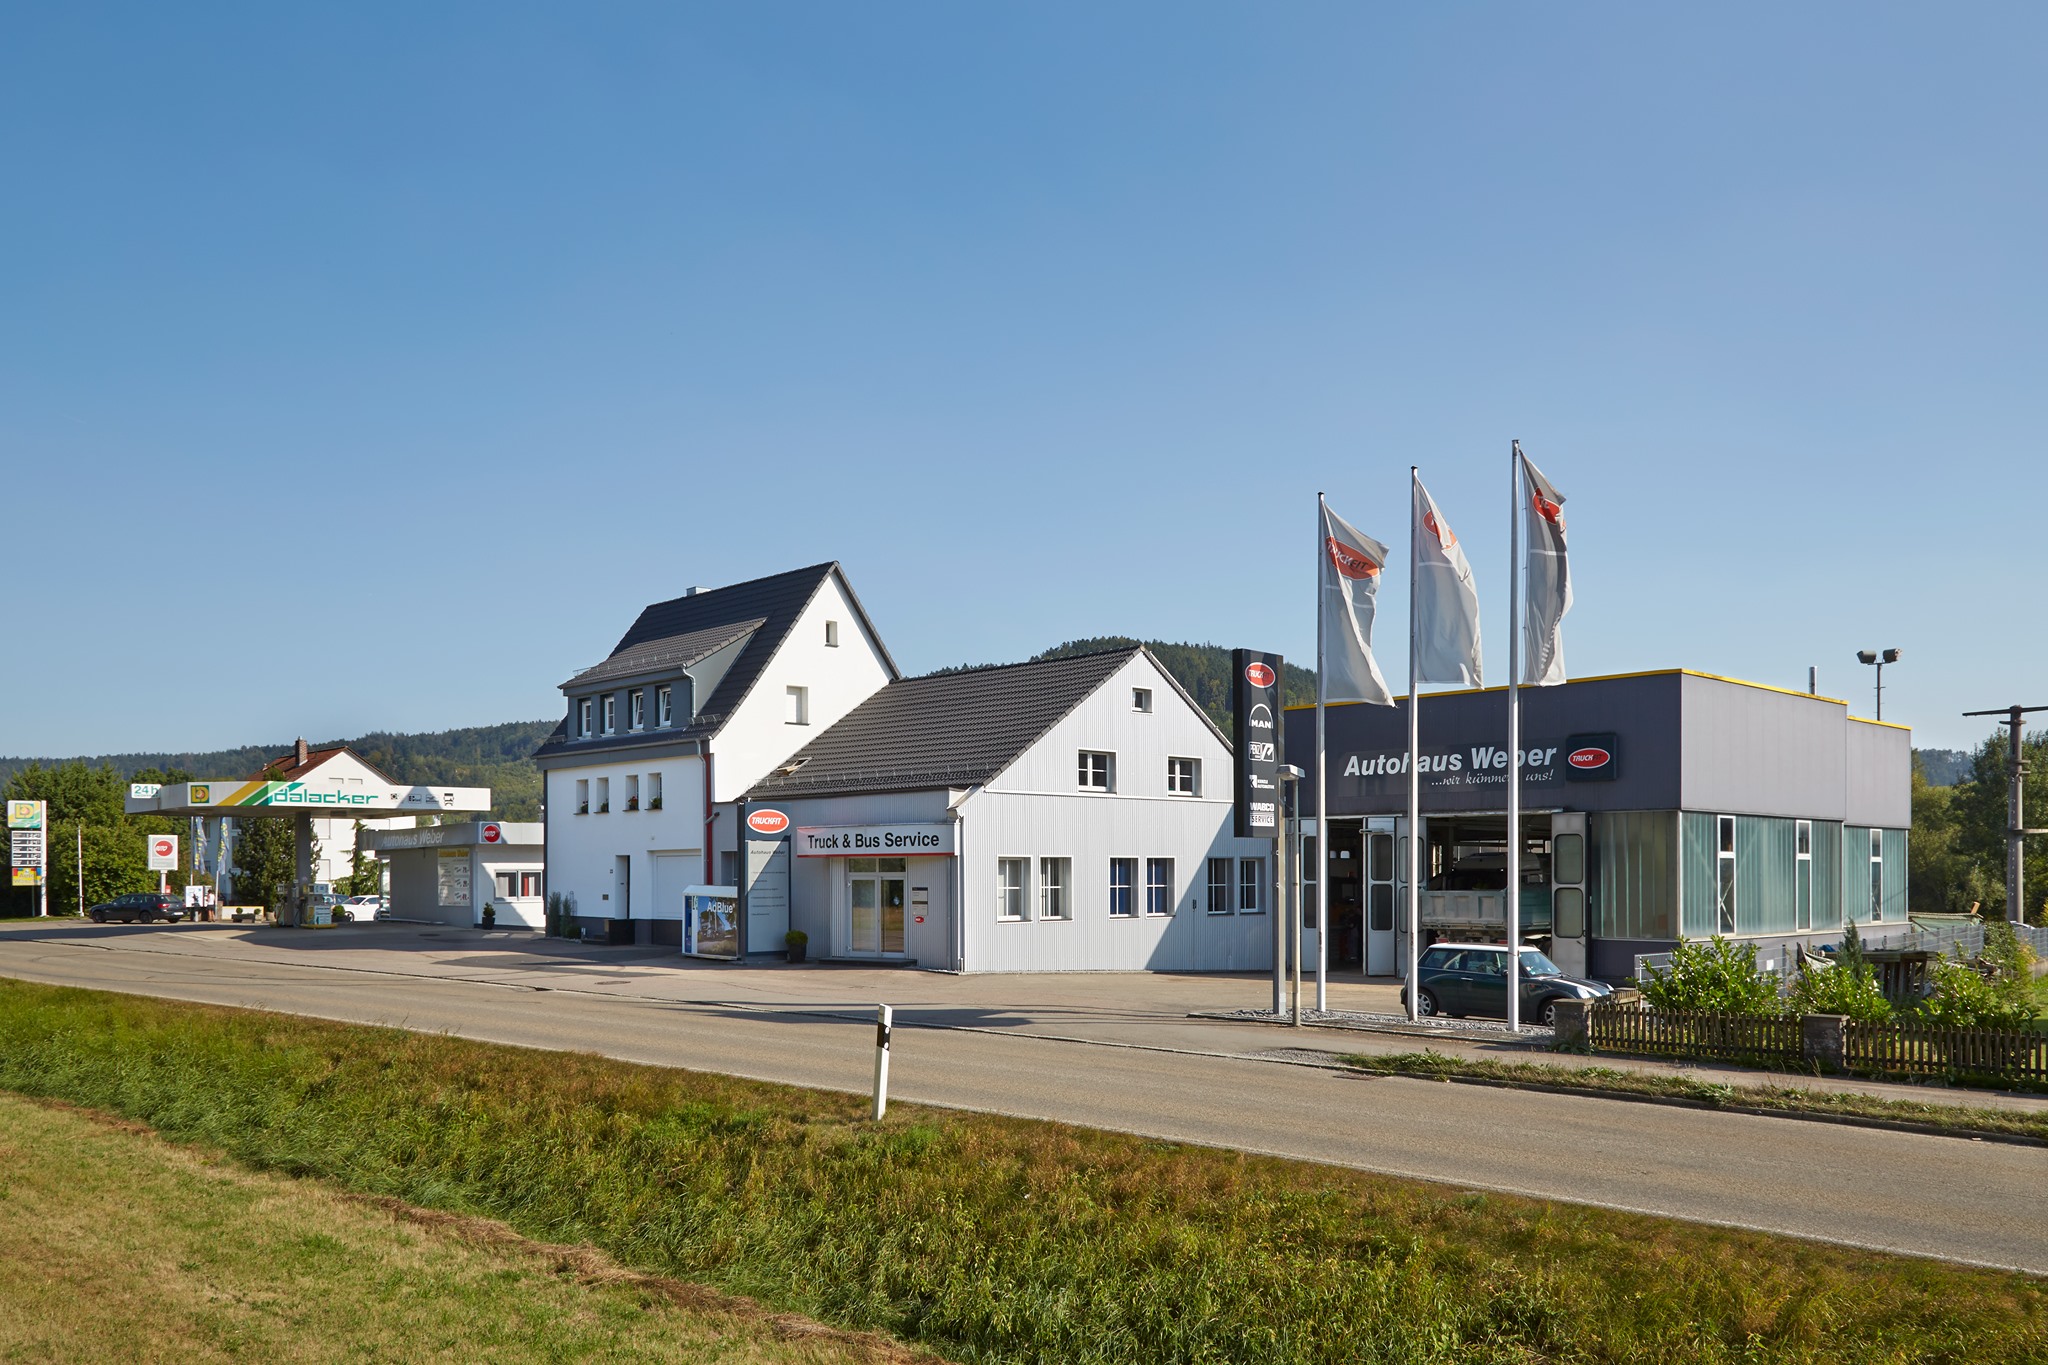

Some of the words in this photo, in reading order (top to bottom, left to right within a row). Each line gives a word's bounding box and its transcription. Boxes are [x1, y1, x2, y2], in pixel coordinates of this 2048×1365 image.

[1251, 719, 1271, 728] MAN
[1525, 769, 1554, 781] uns!
[274, 788, 379, 804] dalacker
[1250, 802, 1275, 812] WABCO
[751, 816, 782, 825] TRUCKFIT
[1251, 815, 1273, 824] SERVICE
[382, 833, 417, 847] Autohaus
[420, 829, 445, 844] Weber
[808, 834, 838, 848] Truck
[842, 833, 851, 848] &
[855, 833, 880, 848] Bus
[884, 831, 940, 847] Service
